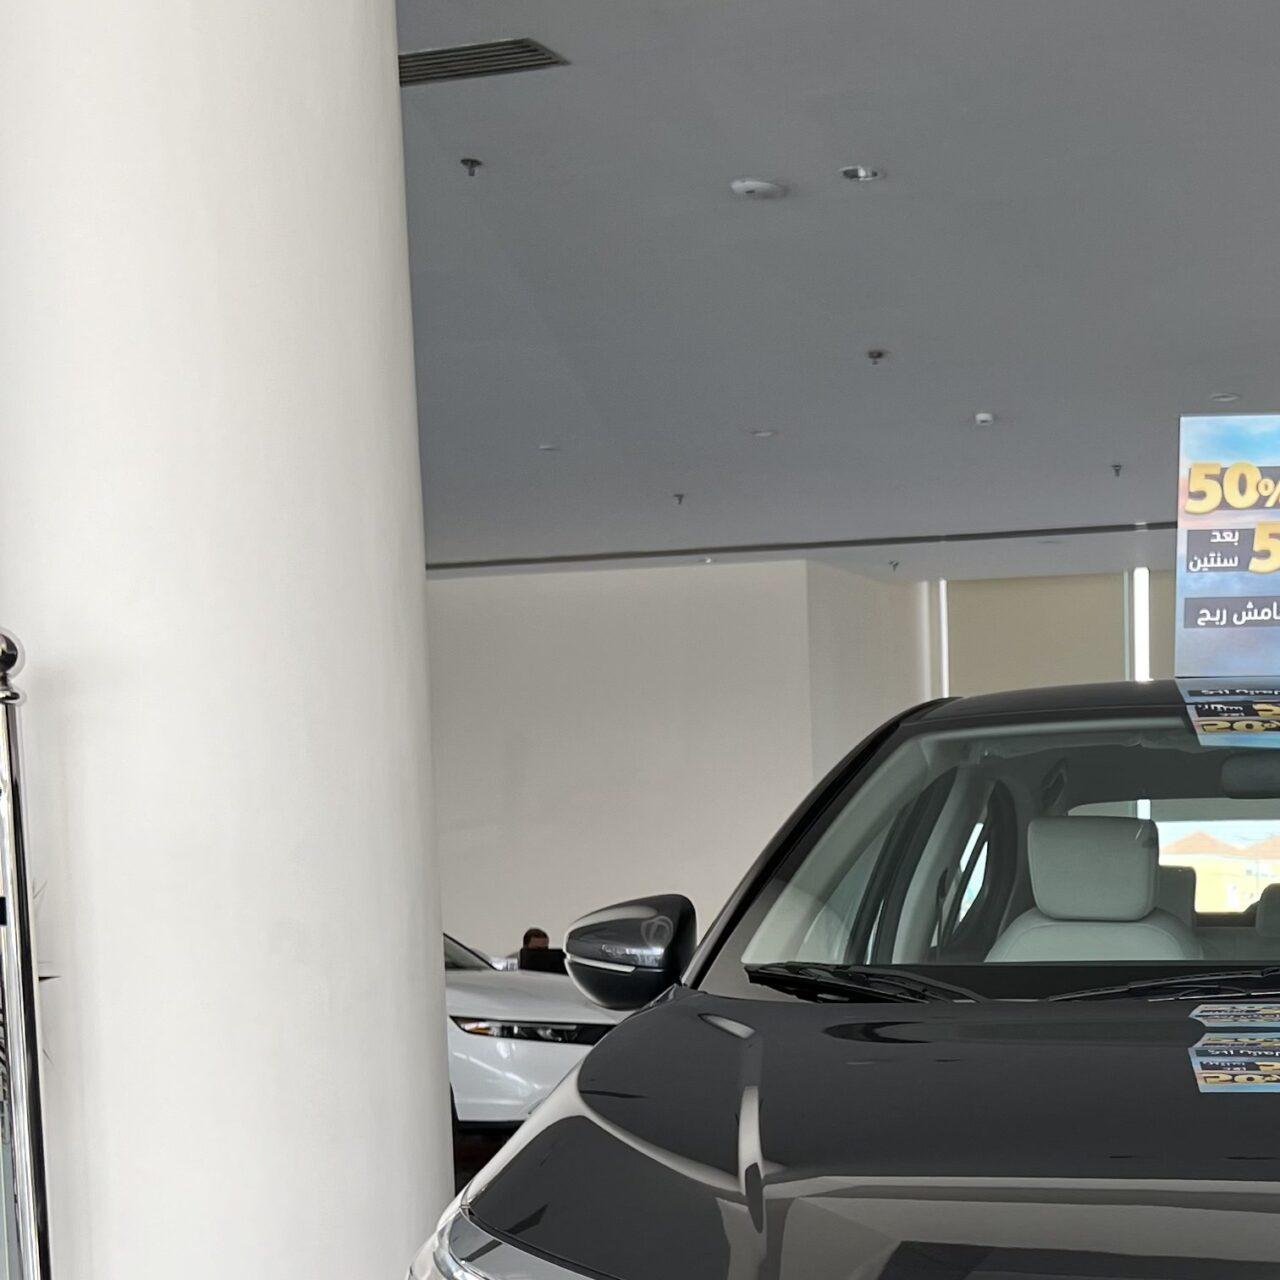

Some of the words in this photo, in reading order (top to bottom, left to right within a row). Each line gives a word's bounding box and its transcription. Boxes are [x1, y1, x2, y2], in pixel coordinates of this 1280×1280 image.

[1210, 529, 1240, 546] بعد
[1188, 552, 1239, 572] سنتين
[1197, 606, 1227, 626] ربح
